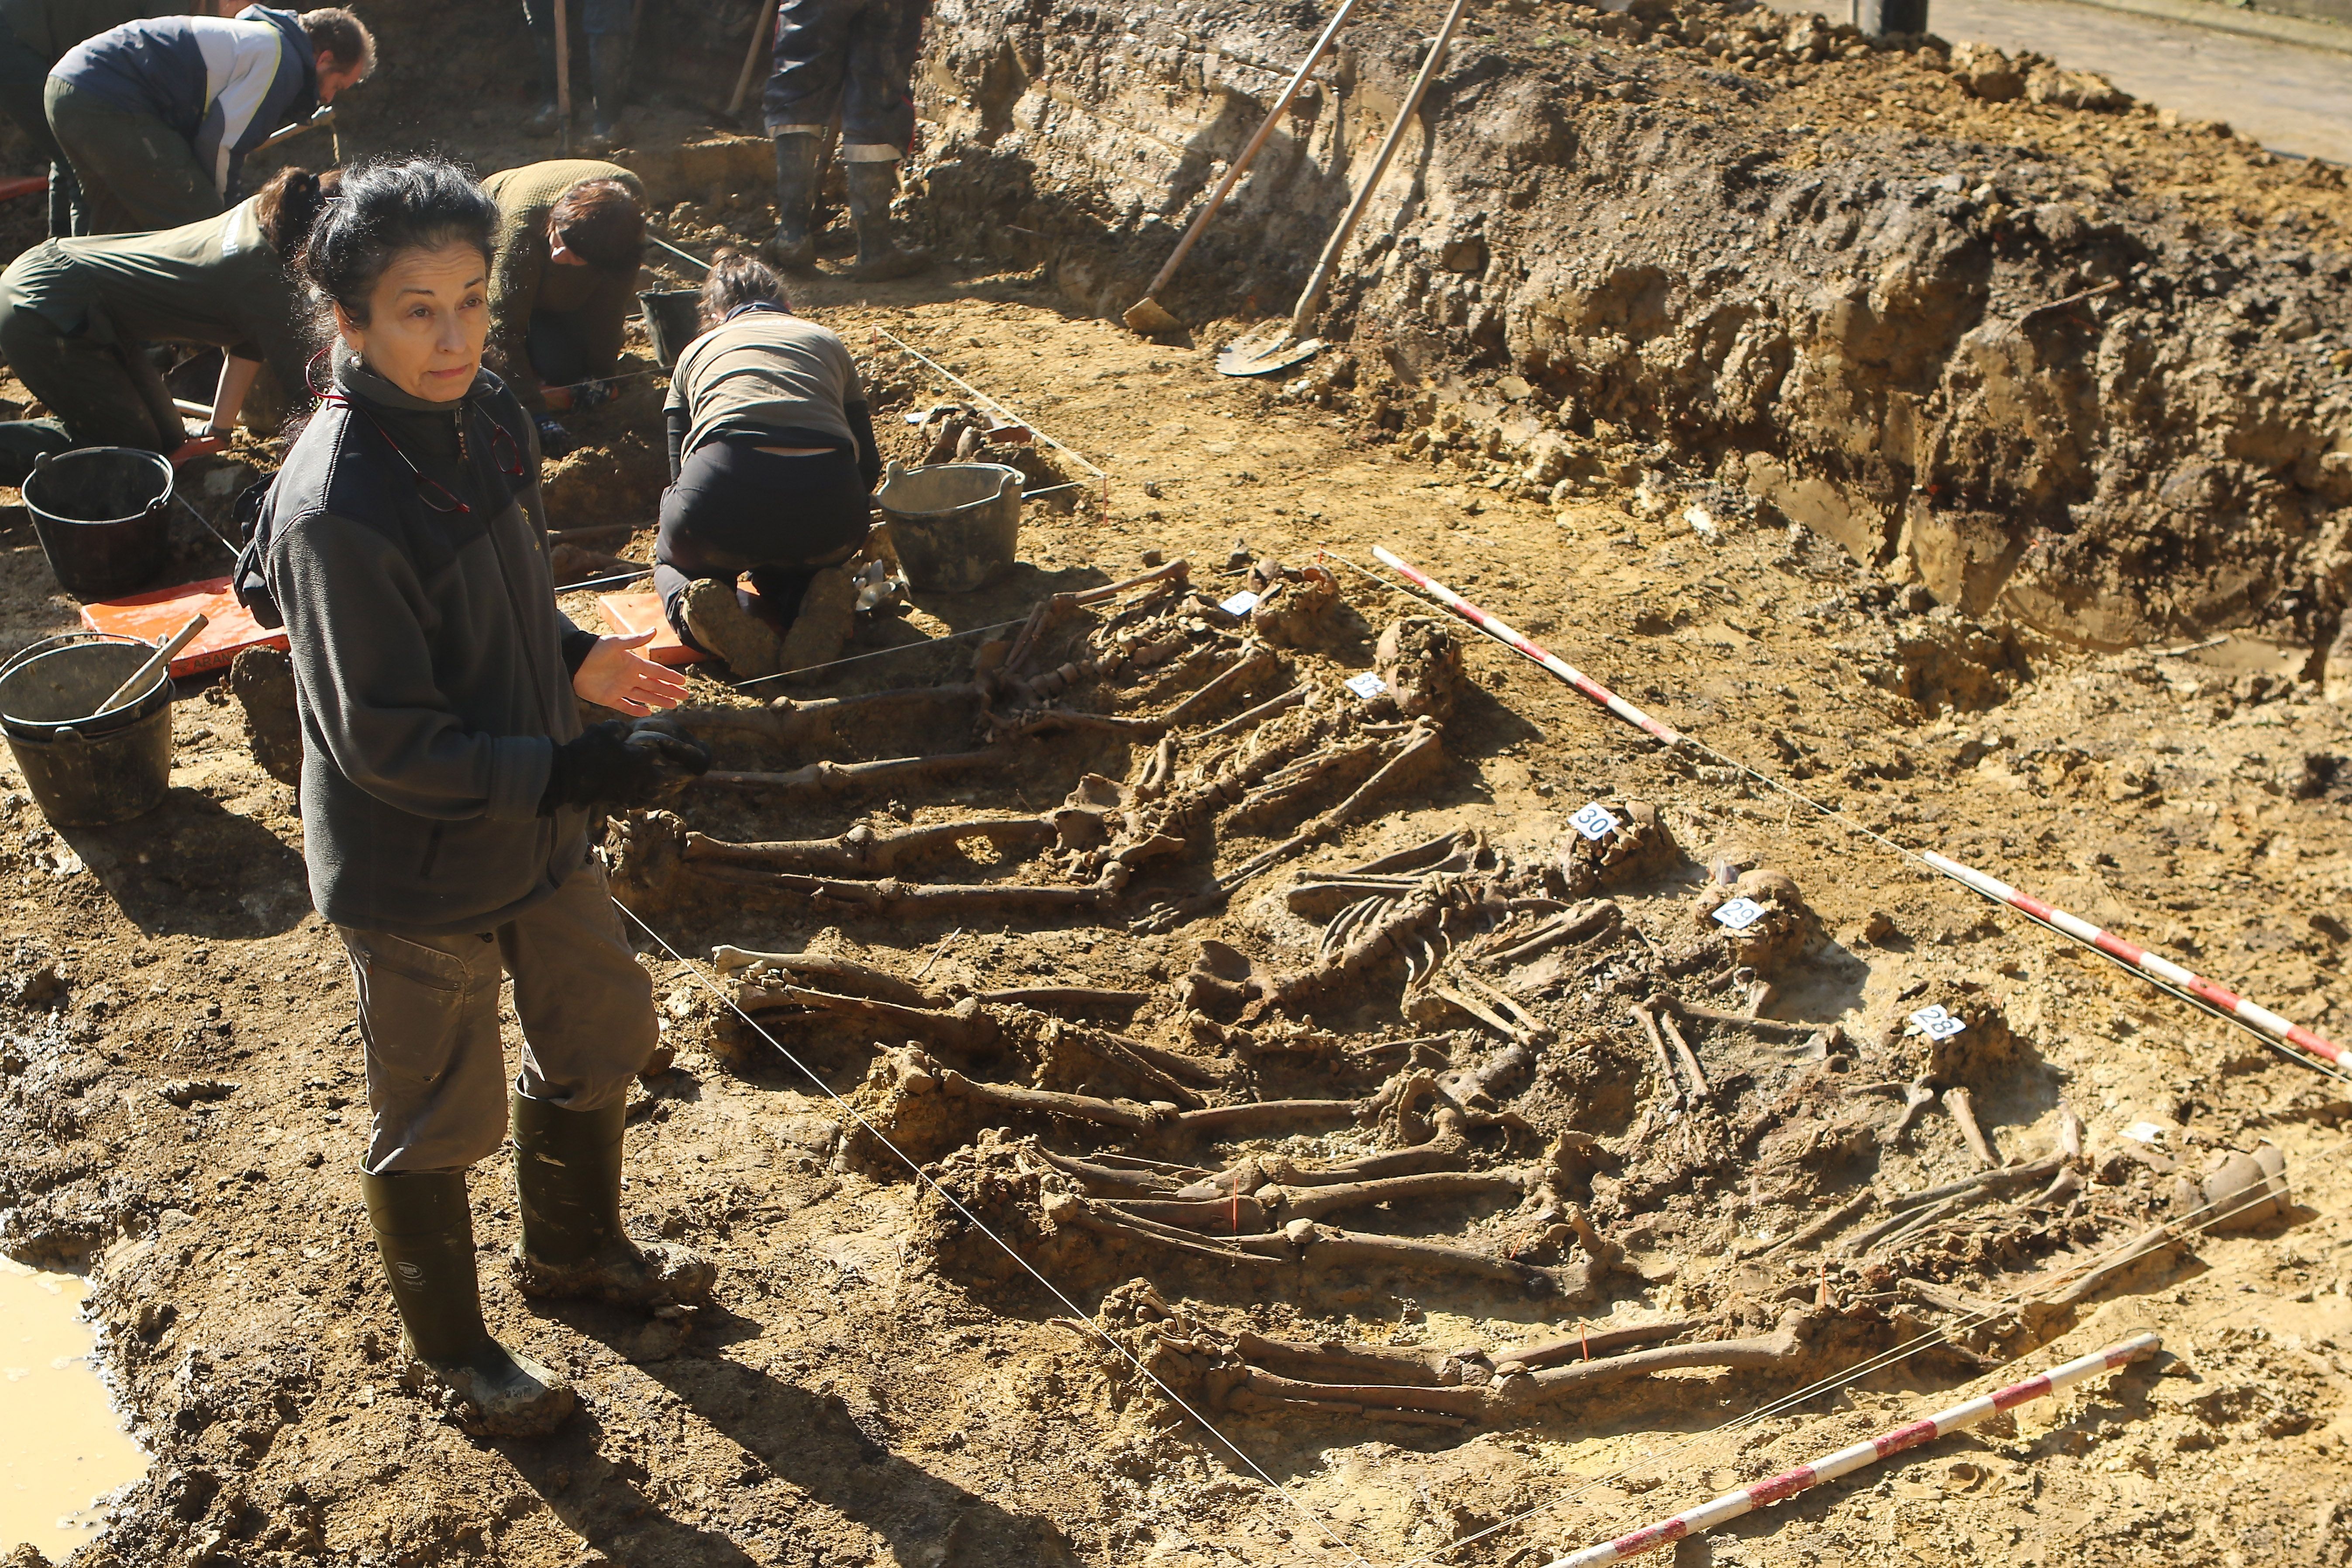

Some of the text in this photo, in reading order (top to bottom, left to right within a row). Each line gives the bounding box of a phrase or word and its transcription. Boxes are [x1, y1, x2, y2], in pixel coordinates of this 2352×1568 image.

[1229, 595, 1253, 610] 32
[1354, 675, 1381, 692] 31
[1577, 808, 1609, 834] 30
[1722, 902, 1754, 923] 29
[1917, 1009, 1953, 1034] 28
